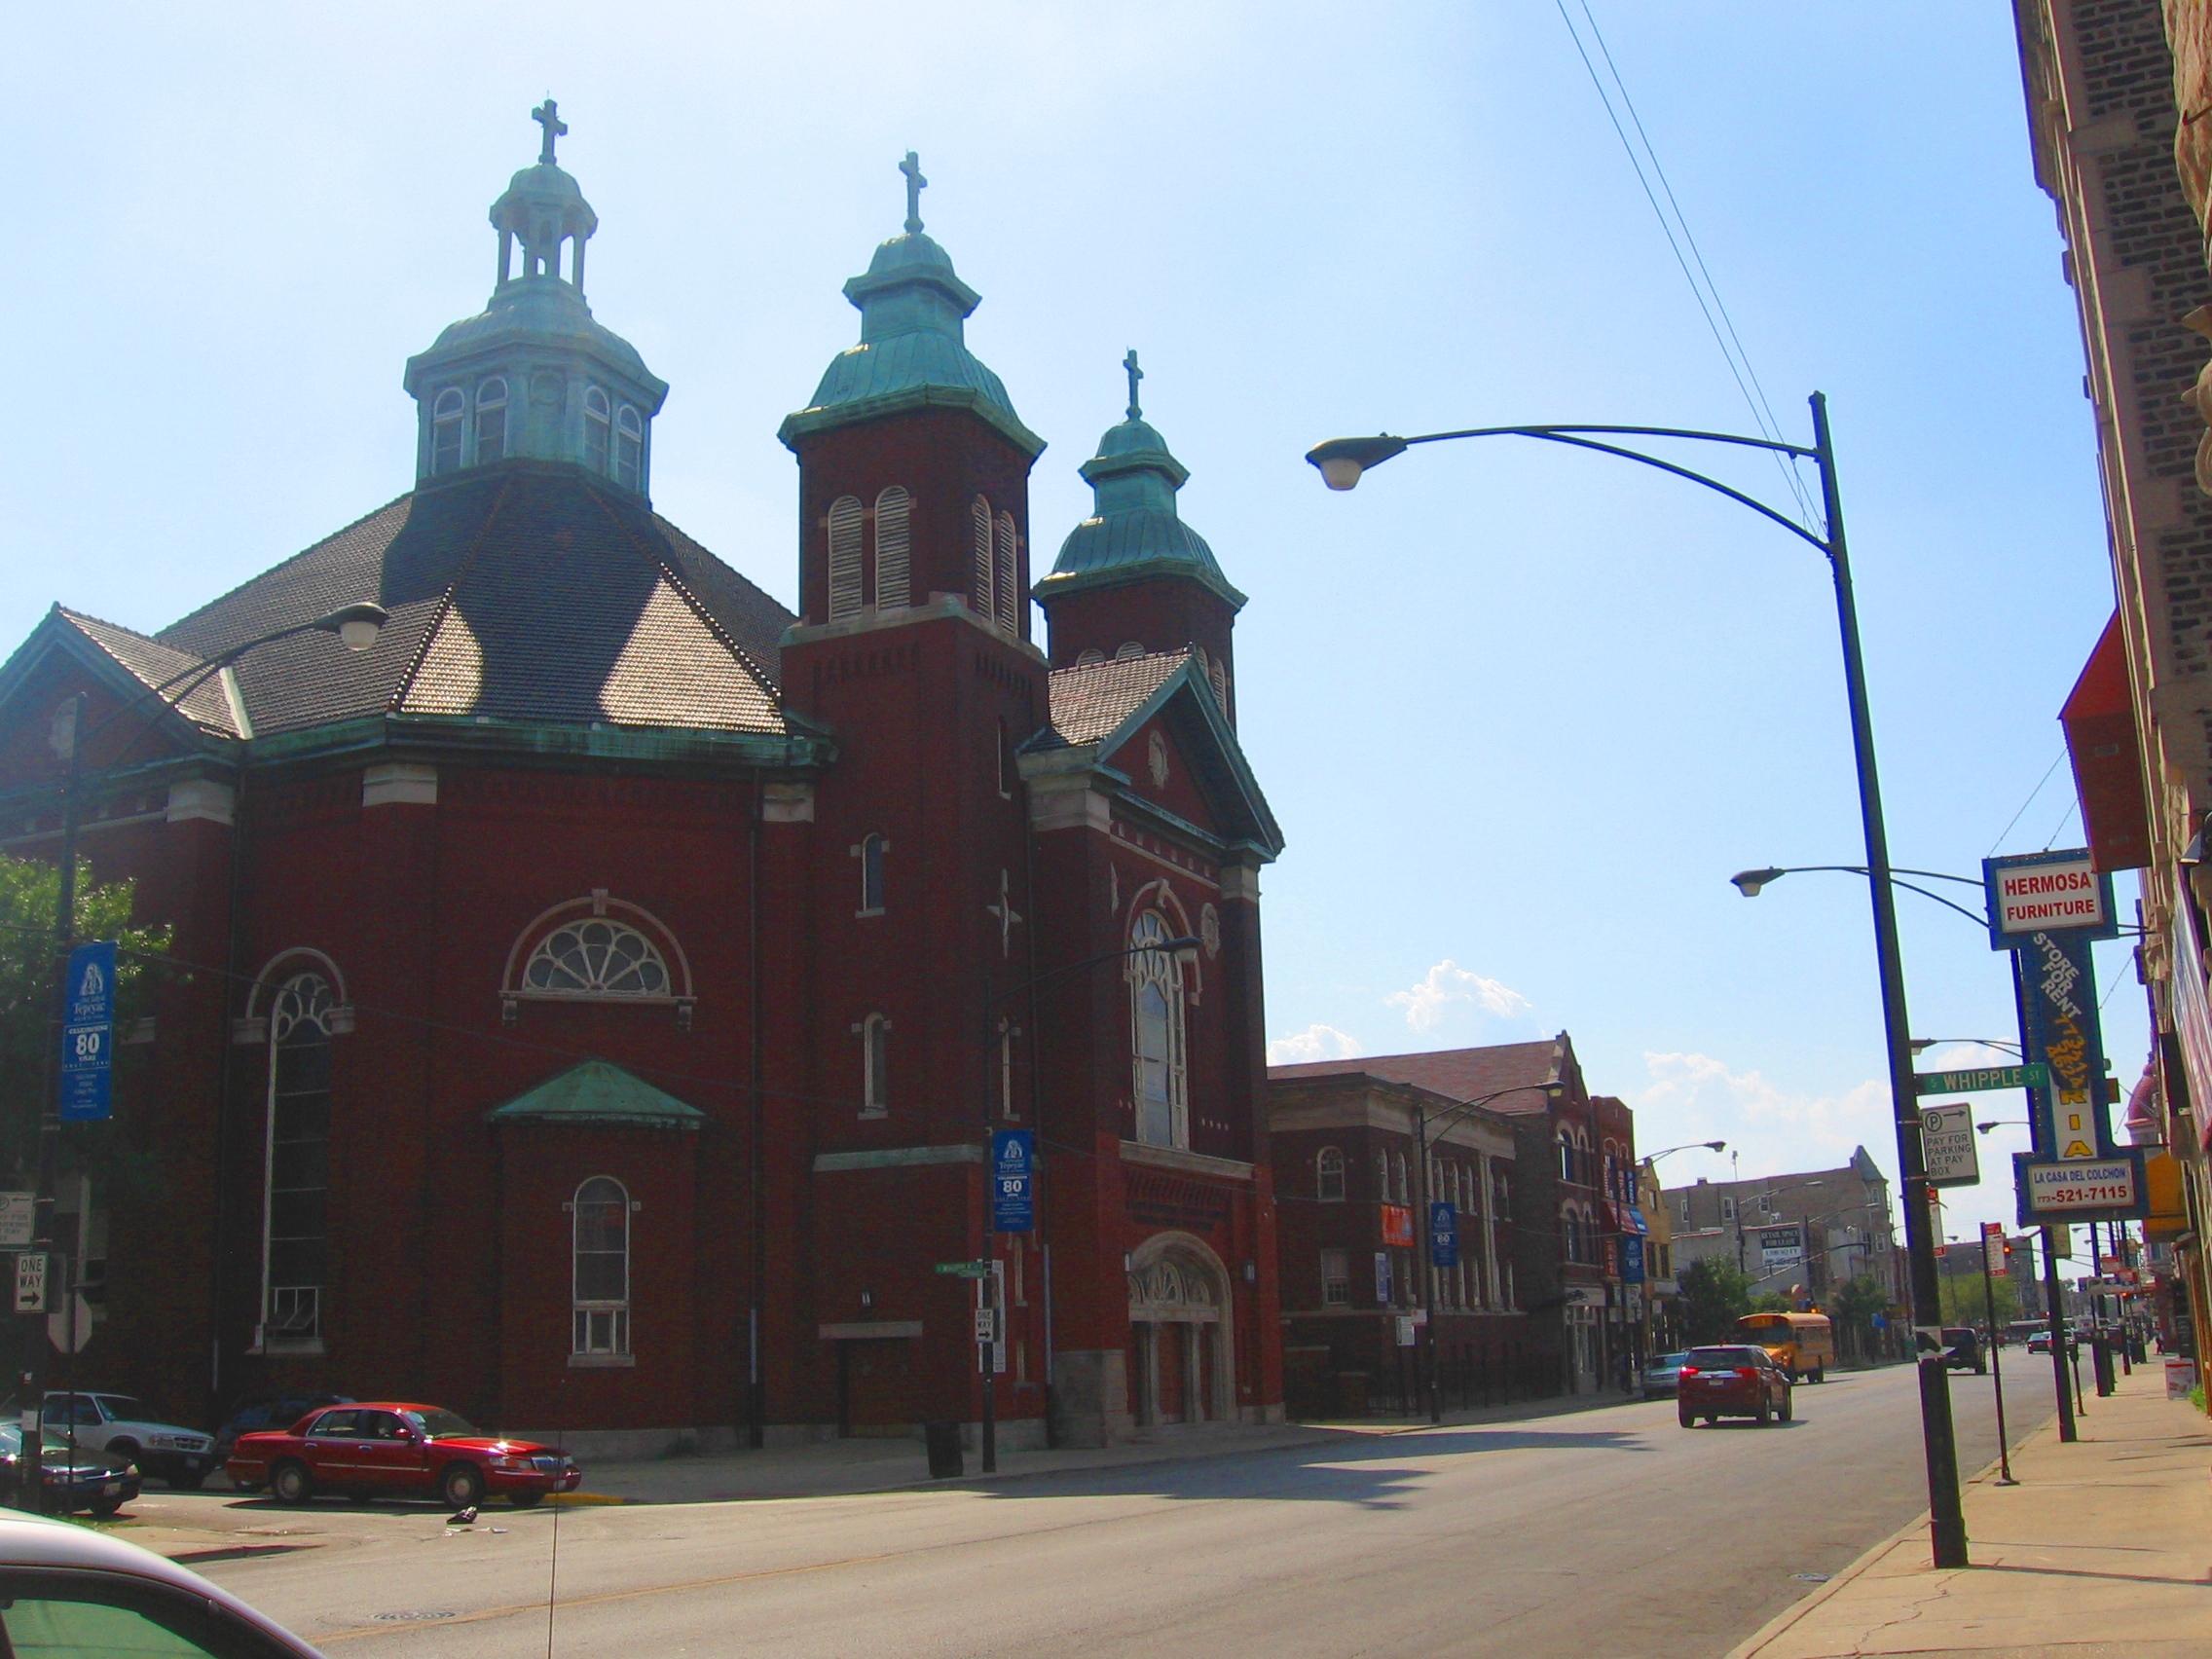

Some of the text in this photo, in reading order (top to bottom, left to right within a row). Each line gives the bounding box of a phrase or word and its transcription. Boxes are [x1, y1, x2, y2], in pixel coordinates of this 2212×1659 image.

[2005, 872, 2091, 897] HERMOSA
[2007, 899, 2095, 921] FURNITURE
[2033, 932, 2080, 981] STORE
[2042, 961, 2073, 996] FOR
[2041, 979, 2082, 1018] RENT
[2055, 1012, 2086, 1049] 773
[75, 1033, 100, 1055] 80
[1931, 1068, 2041, 1090] S WHIPPLE ST
[1928, 1134, 1969, 1147] PAY FOR
[1929, 1144, 1972, 1158] PARKING
[1930, 1155, 1965, 1167] AT PAY
[1932, 1166, 1951, 1176] BOX
[2034, 1168, 2126, 1184] LA CASA DEL COLCHON
[1003, 1179, 1023, 1193] 80
[2037, 1186, 2127, 1204] 773-521-7115
[21, 1258, 44, 1272] ONE
[19, 1273, 44, 1288] WAY
